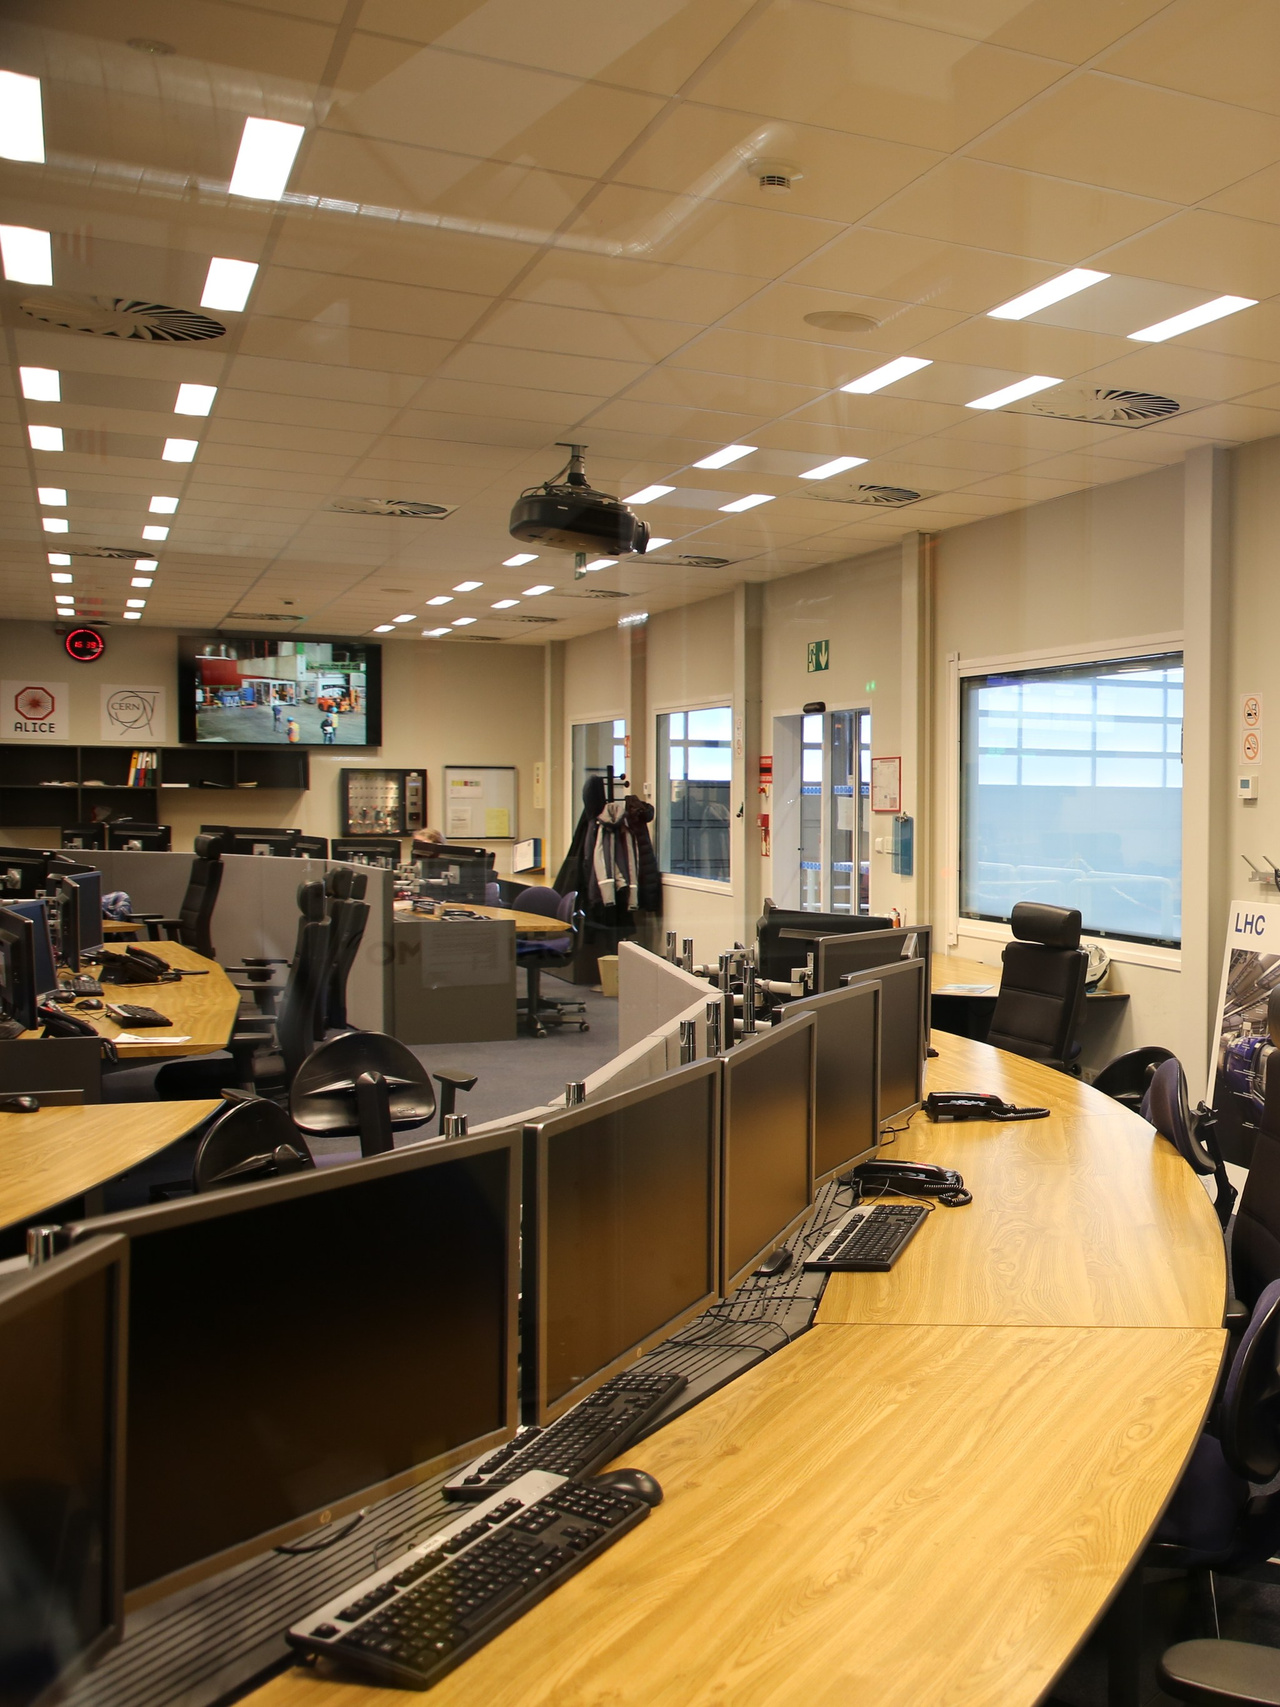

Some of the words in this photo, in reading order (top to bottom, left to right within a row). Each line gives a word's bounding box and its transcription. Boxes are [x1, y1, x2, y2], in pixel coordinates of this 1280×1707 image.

[111, 702, 140, 711] CERN
[14, 721, 56, 733] ALICE
[1234, 912, 1266, 936] LHC
